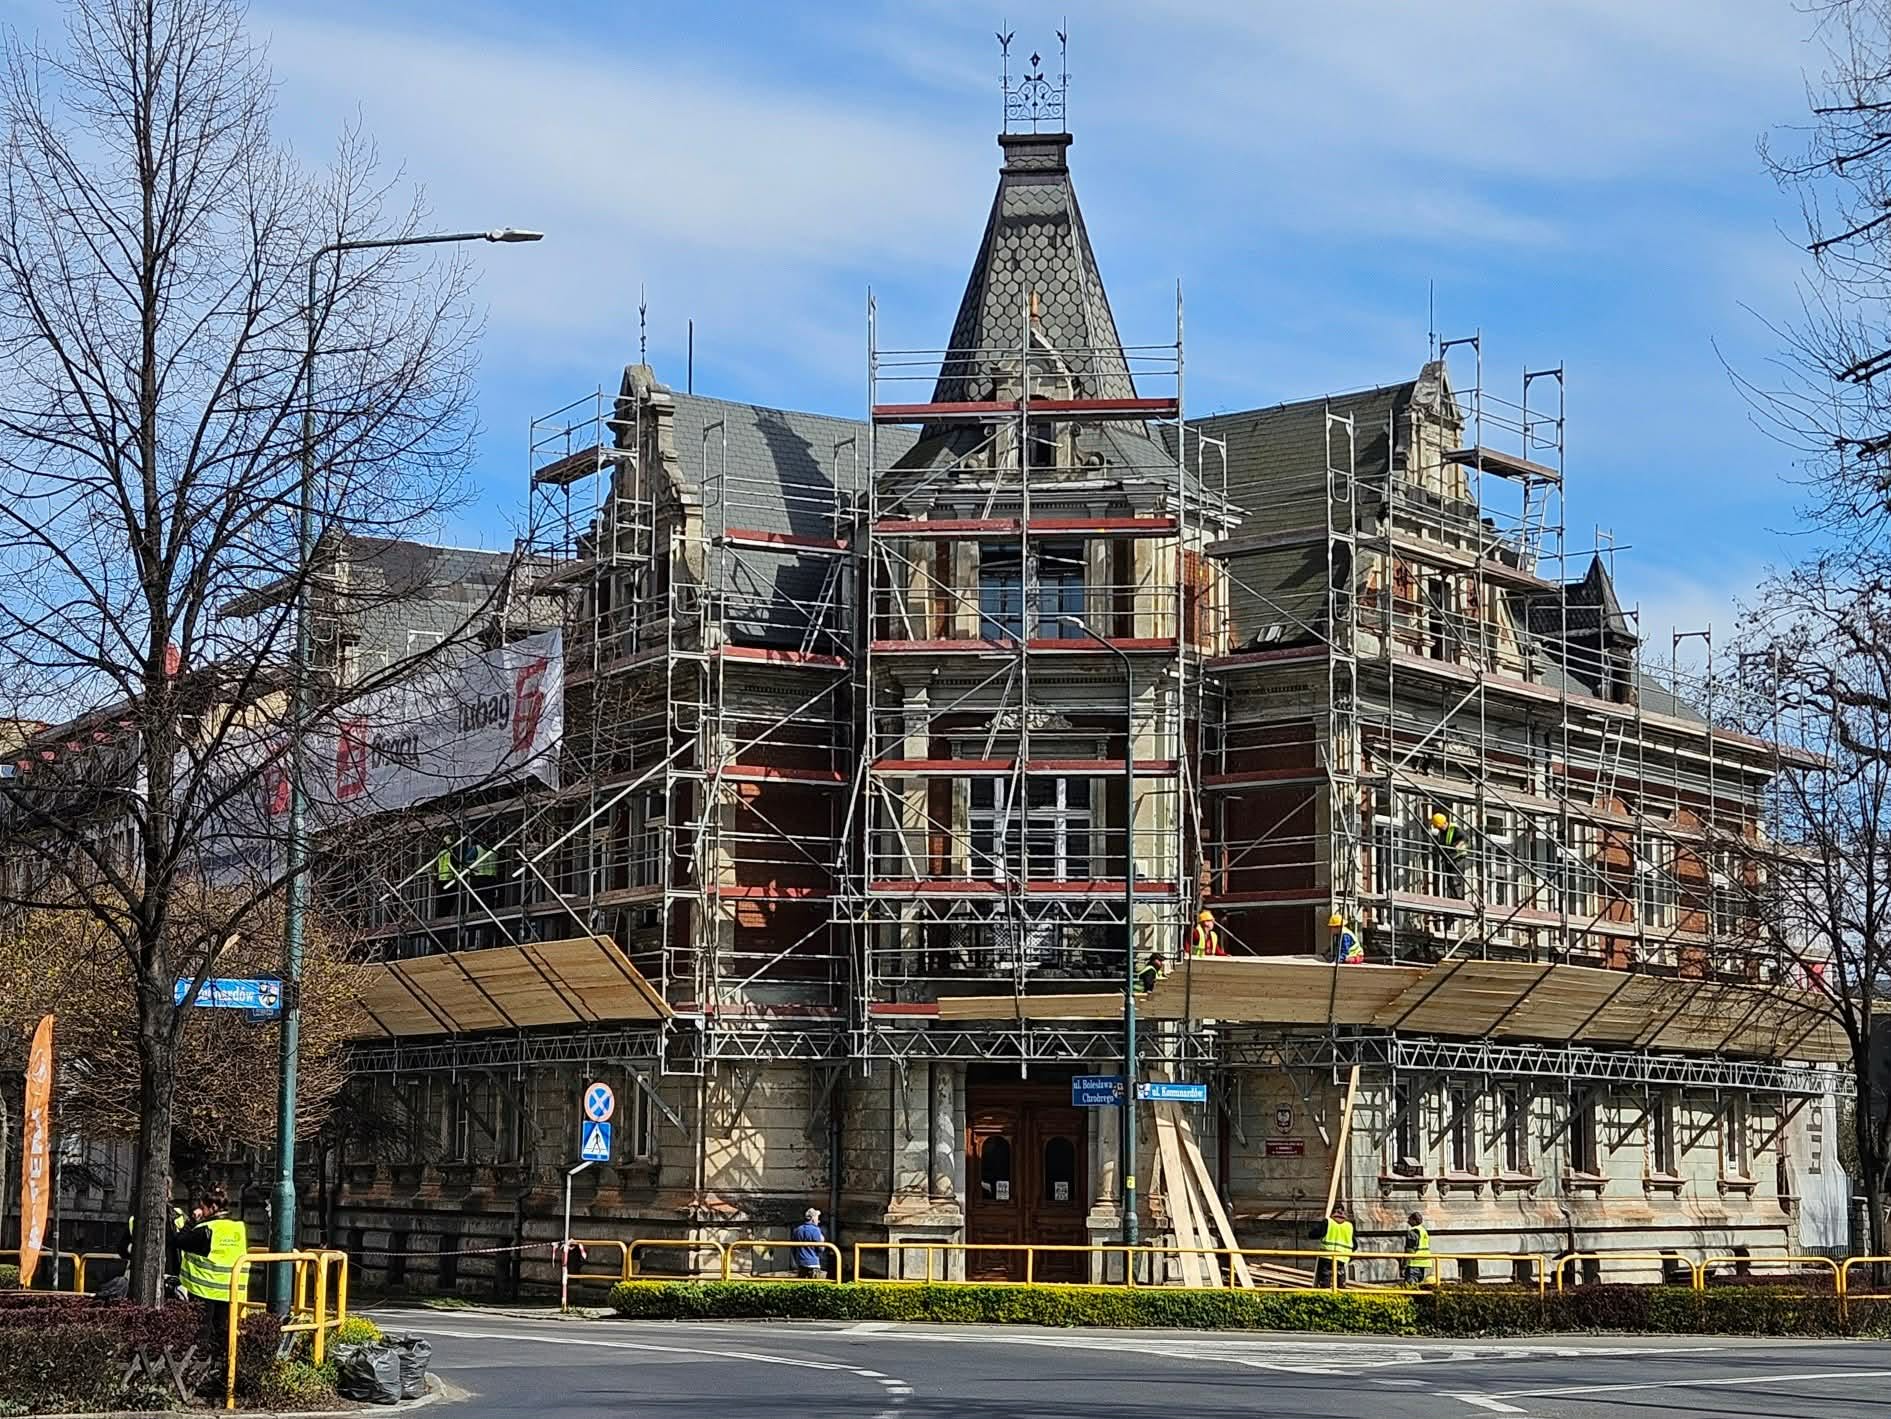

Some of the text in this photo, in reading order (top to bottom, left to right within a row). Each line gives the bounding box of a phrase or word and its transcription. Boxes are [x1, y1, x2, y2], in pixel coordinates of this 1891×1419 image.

[1073, 1080, 1081, 1089] ul.
[1152, 1086, 1160, 1096] ul.
[1082, 1092, 1114, 1104] Chrobrego
